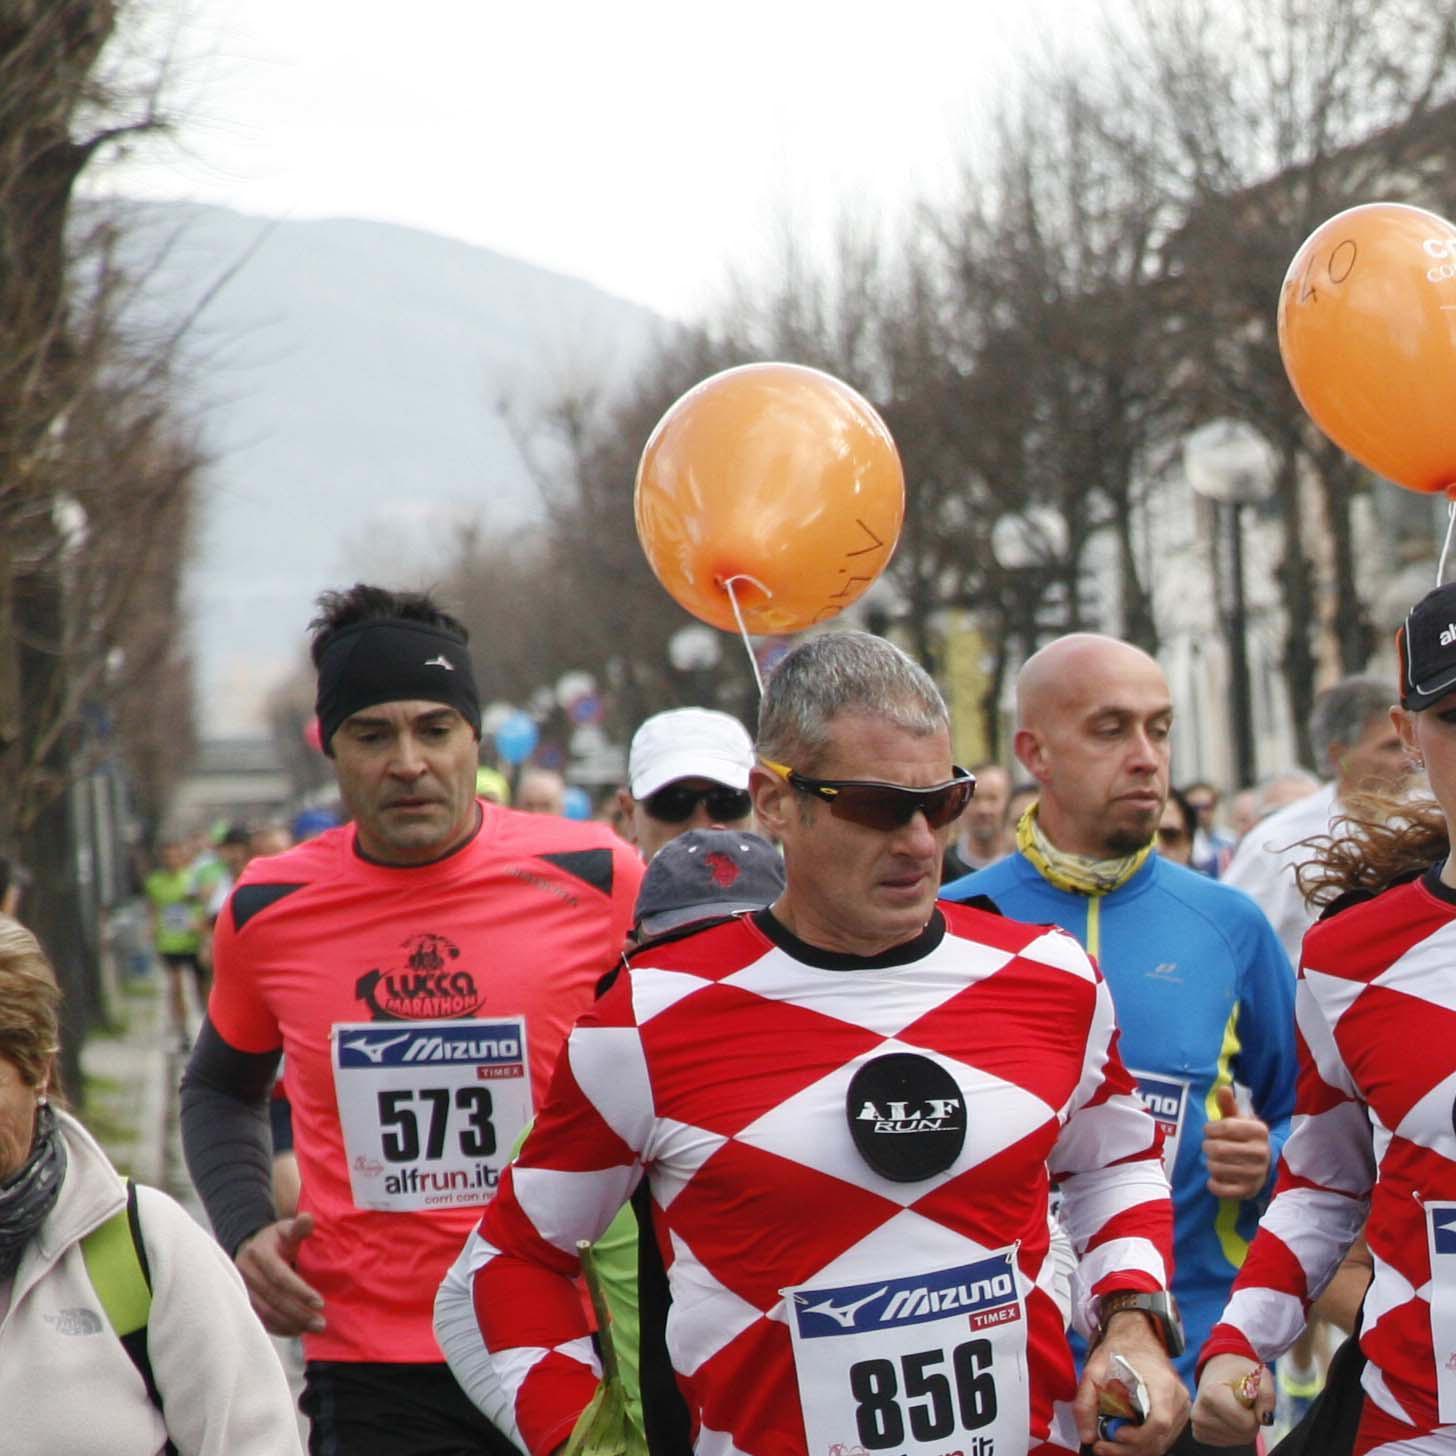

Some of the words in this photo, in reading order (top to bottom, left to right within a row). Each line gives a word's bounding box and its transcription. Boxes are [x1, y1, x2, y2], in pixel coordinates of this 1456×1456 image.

[481, 1067, 520, 1078] TIMEX
[856, 1098, 960, 1121] ALF
[378, 1086, 497, 1163] 573
[874, 1119, 943, 1133] RUN
[385, 1164, 498, 1194] alfrun.it
[974, 1308, 1017, 1327] TIMEX
[850, 1338, 997, 1450] 856
